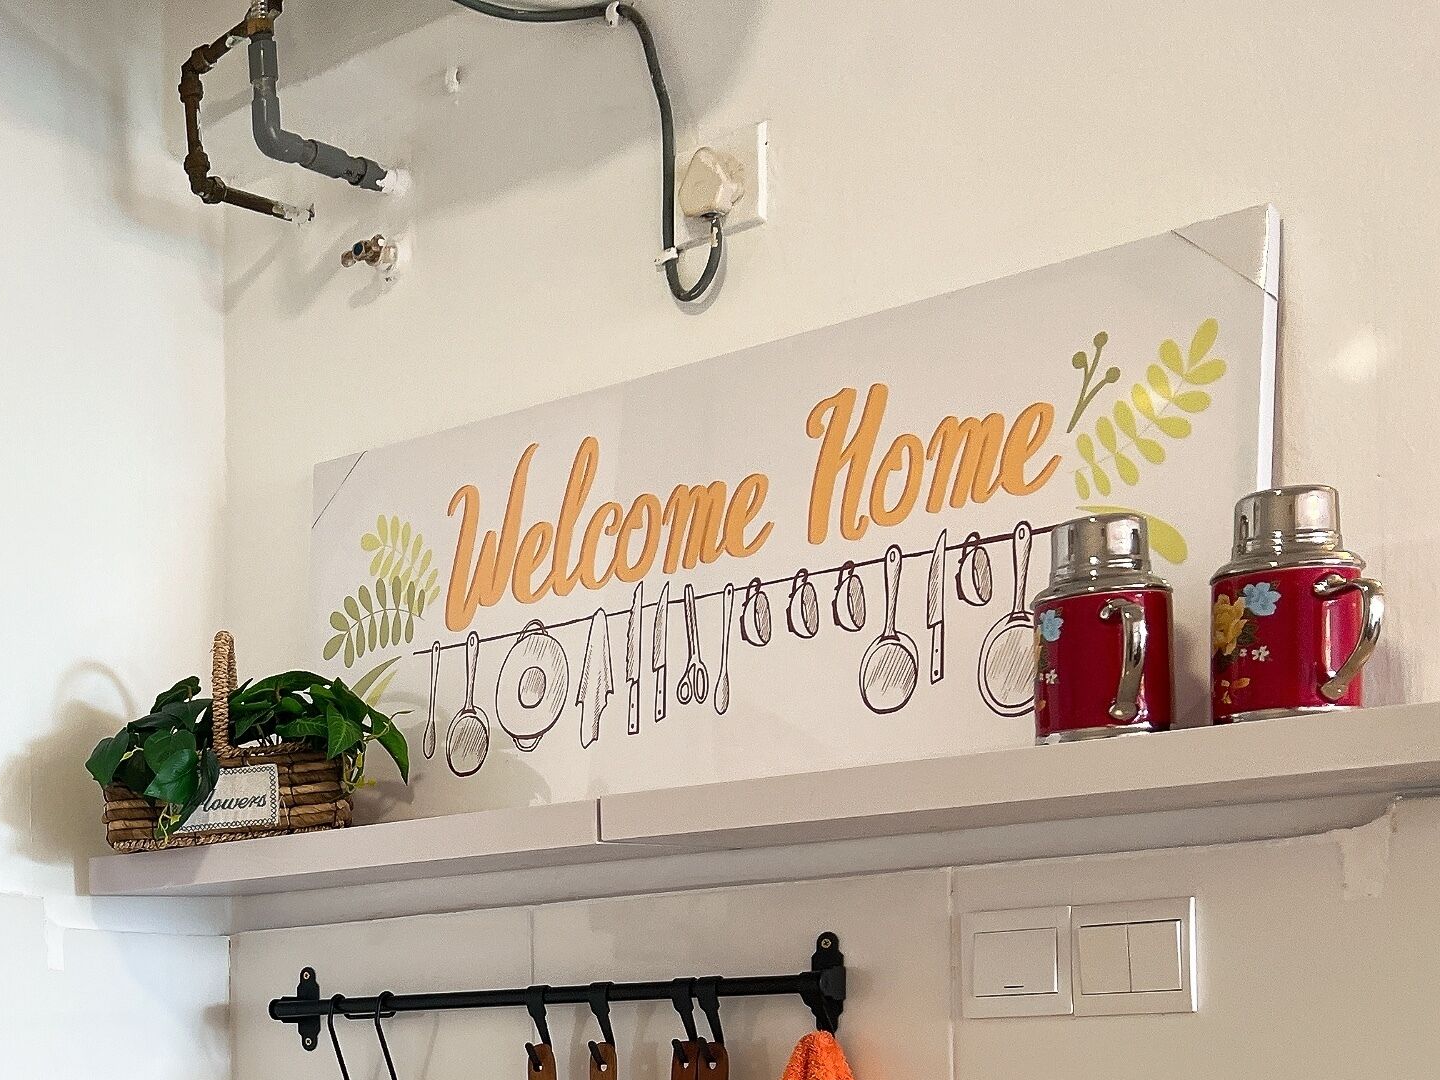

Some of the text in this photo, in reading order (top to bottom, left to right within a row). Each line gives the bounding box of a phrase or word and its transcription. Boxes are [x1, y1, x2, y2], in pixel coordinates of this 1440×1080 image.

[445, 382, 1062, 632] Welcome Home
[199, 788, 267, 813] lowers
